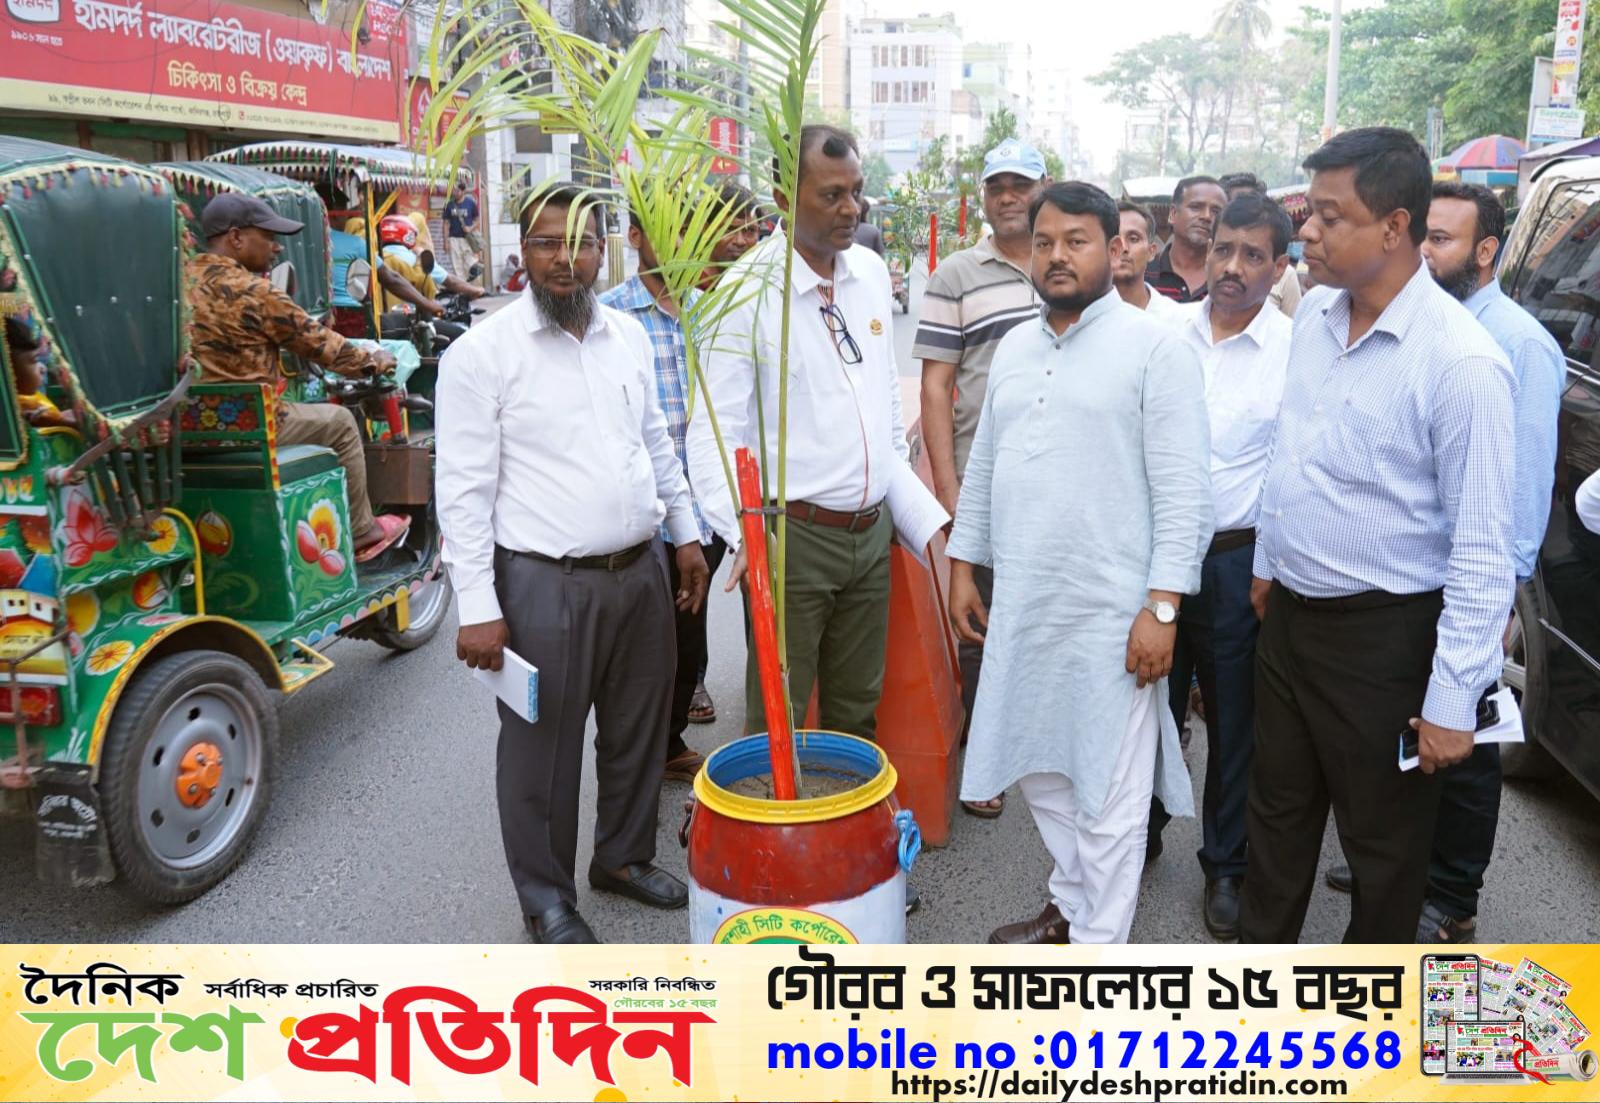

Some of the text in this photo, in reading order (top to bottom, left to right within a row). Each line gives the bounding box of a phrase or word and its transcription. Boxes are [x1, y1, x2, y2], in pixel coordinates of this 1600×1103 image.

[72, 0, 143, 38] হামদর্দ
[167, 60, 308, 107] চিকিৎসা ও বিক্রয় কেন্দ্র
[752, 914, 784, 932] সিটি
